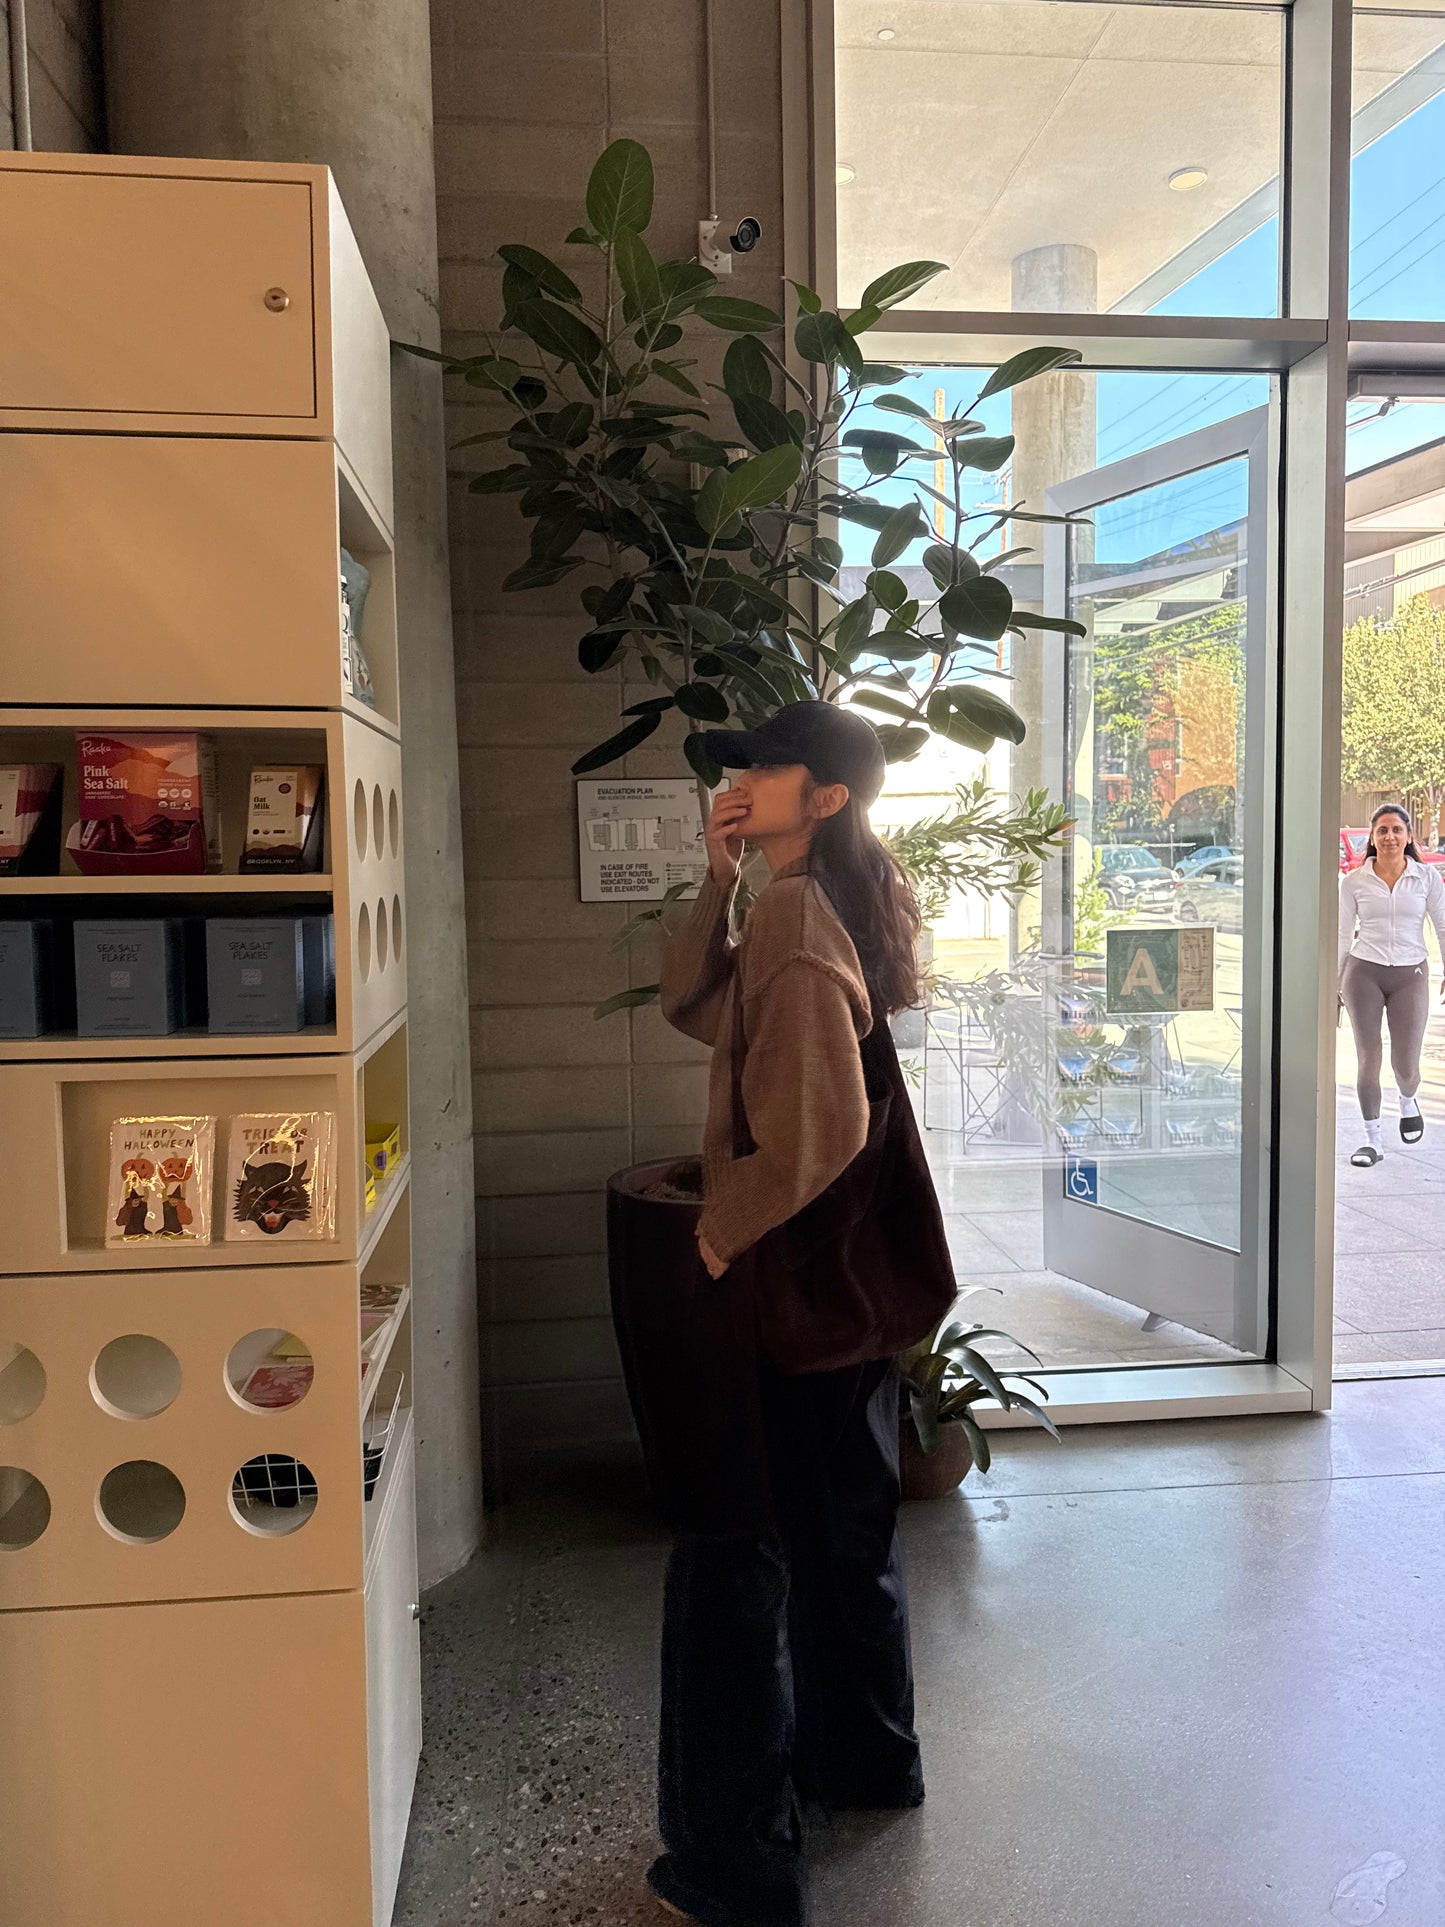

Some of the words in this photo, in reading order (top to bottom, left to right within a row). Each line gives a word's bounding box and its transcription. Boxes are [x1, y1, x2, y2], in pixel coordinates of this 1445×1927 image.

[83, 765, 109, 777] Pink
[84, 778, 104, 789] Sea
[106, 778, 128, 789] Salt
[96, 943, 116, 953] SEA
[117, 943, 142, 953] SALT
[228, 941, 246, 951] SEA
[248, 941, 273, 951] SALT
[101, 953, 137, 962] FLAKES
[233, 951, 269, 960] FLAKES
[1119, 947, 1164, 996] A
[140, 1128, 176, 1139] HAPPY
